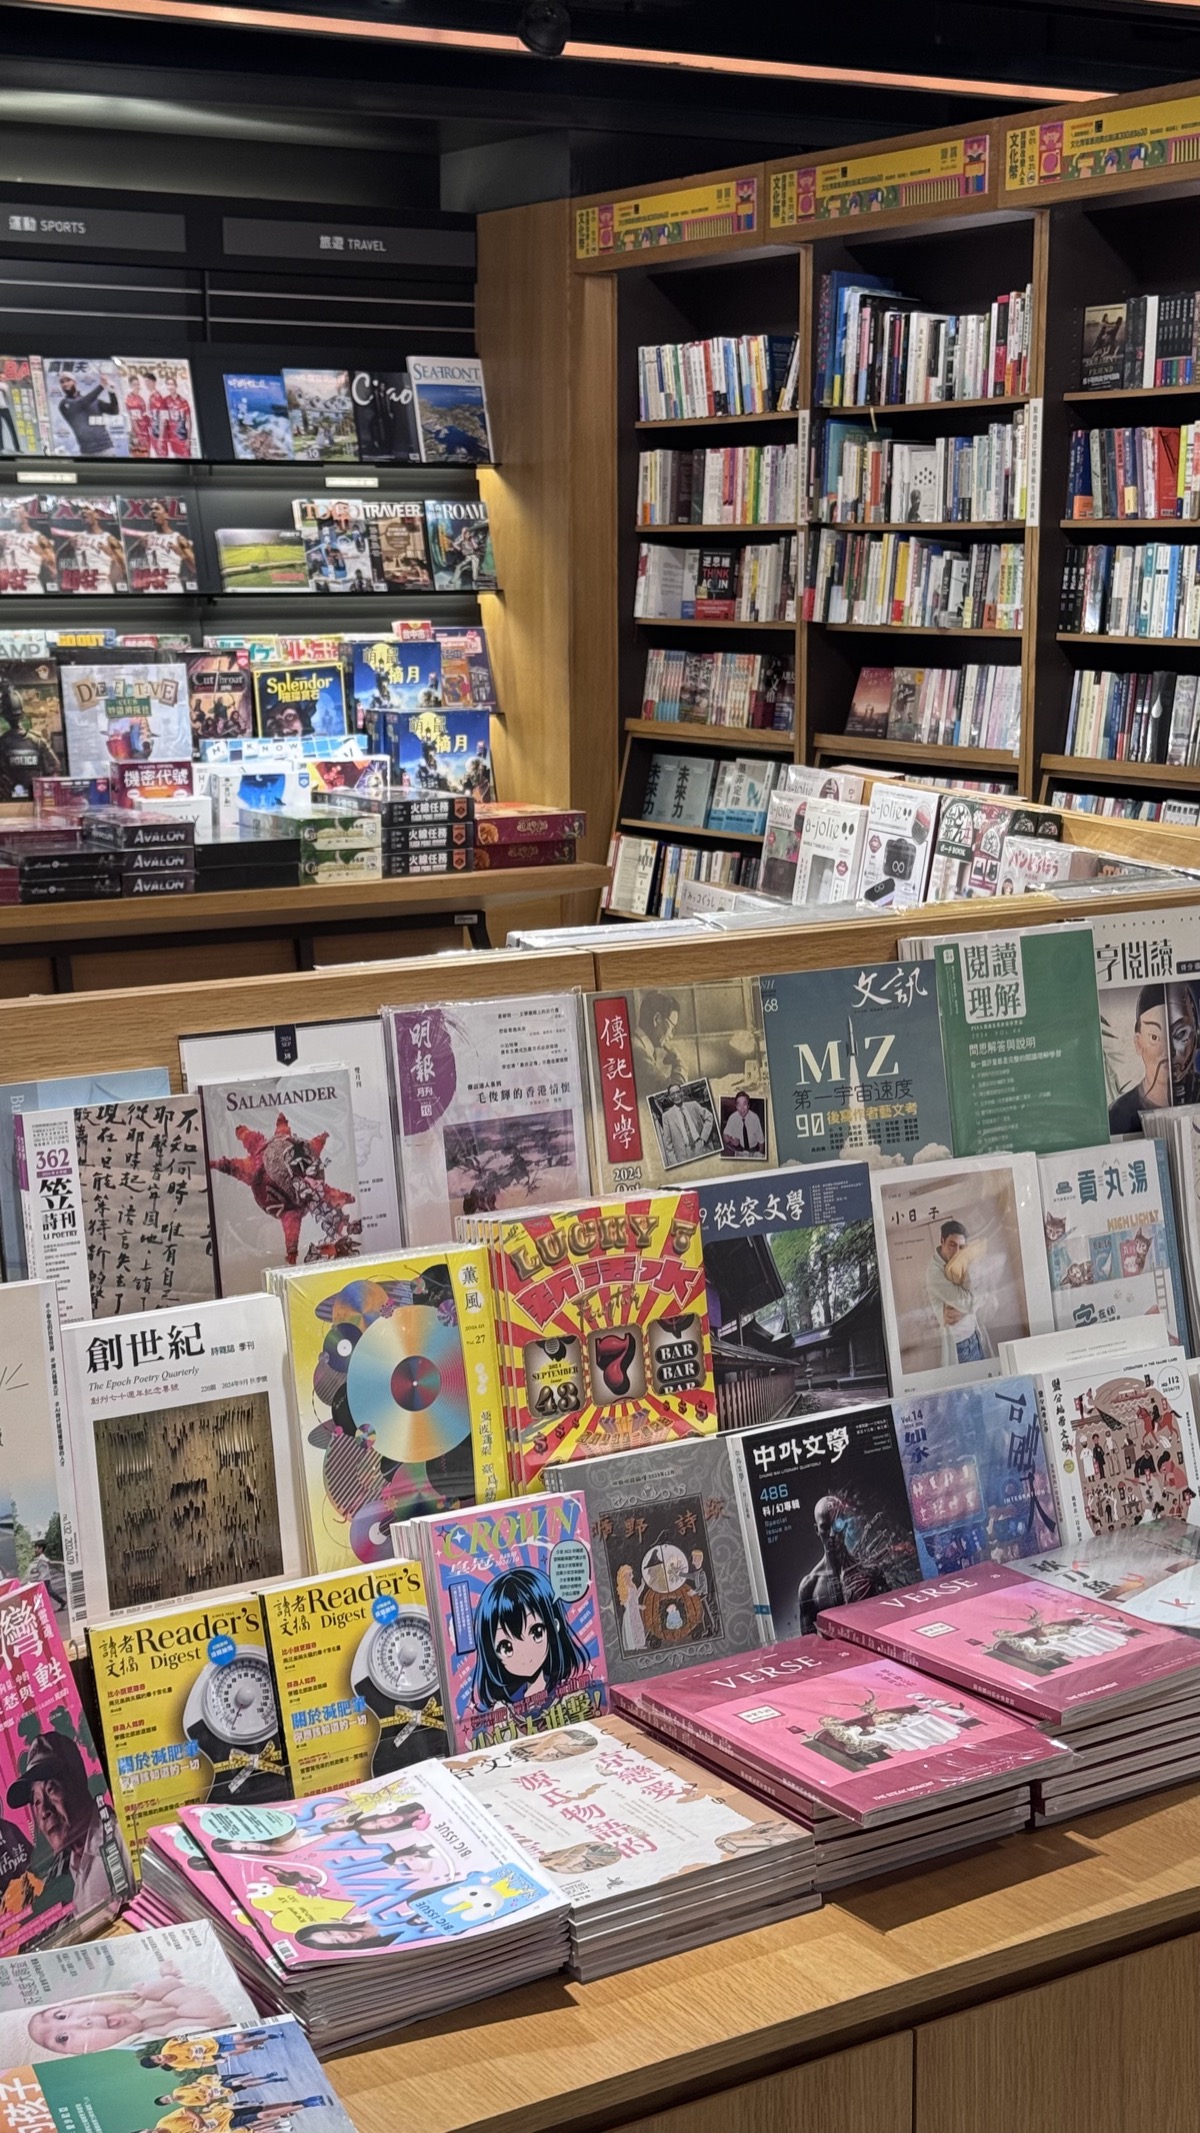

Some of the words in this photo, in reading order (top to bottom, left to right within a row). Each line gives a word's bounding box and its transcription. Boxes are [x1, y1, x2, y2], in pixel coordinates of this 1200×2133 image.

[8, 215, 37, 232] 運動
[40, 220, 87, 234] SPORTS
[348, 238, 386, 252] TRAVEL
[413, 363, 481, 381] SEAFRONT
[352, 373, 413, 406] Ciao
[443, 505, 486, 520] ROAM
[703, 557, 731, 568] 逆思維
[703, 568, 729, 579] THINK
[266, 672, 333, 694] Splendor
[388, 665, 420, 684] 摘月
[435, 734, 468, 753] 摘月
[124, 770, 188, 787] 機密代號
[642, 762, 661, 815] 未來力
[671, 765, 690, 819] 未來力
[410, 800, 449, 815] 火線任務
[871, 801, 904, 821] a-jolie
[134, 830, 186, 844] AVALON
[408, 827, 447, 842] 火線任務
[805, 819, 840, 840] a-jolie
[133, 856, 184, 868] AVALON
[409, 853, 447, 868] 火線任務
[132, 880, 184, 892] AVALON
[963, 942, 1019, 981] 閱讀
[851, 967, 928, 1008] 文訊
[968, 981, 1022, 1019] 理解
[409, 1019, 436, 1083] 明報
[416, 1086, 433, 1097] 月刊
[477, 1082, 571, 1104] 毛俊輝的香港情懷
[600, 1016, 635, 1150] 傳記文學
[792, 1078, 914, 1110] 第一宇宙速度
[226, 1086, 338, 1111] SALAMANDER
[421, 1105, 432, 1116] 10
[36, 1149, 70, 1169] 362
[613, 1167, 643, 1181] 2024
[1077, 1159, 1149, 1206] 貢丸湯
[713, 1188, 805, 1231] 從容文學
[890, 1206, 940, 1225] 小日子
[42, 1211, 76, 1232] 詩刊
[43, 1230, 50, 1240] LI
[52, 1229, 78, 1239] POETRY
[510, 1214, 660, 1281] LUCKY
[461, 1265, 482, 1310] 薰風
[513, 1255, 704, 1331] 新活水
[86, 1322, 205, 1374] 創世紀
[239, 1341, 255, 1351] 季刊
[661, 1343, 695, 1361] BAR
[532, 1366, 579, 1382] SEPTEMBER
[595, 1332, 637, 1396] 7
[662, 1363, 696, 1381] BAR
[89, 1382, 104, 1392] The
[106, 1376, 132, 1390] Epoch
[133, 1372, 160, 1386] Poetry
[161, 1366, 200, 1380] Quarterly
[664, 1381, 697, 1394] BAR
[900, 1409, 924, 1424] Vol.14
[753, 1426, 850, 1472] 中外文學
[759, 1484, 789, 1502] 486
[1003, 1489, 1045, 1504] INTEGRATION
[762, 1500, 800, 1517] 科/幻專輯
[442, 1499, 577, 1560] CROWN
[764, 1517, 788, 1527] Special
[765, 1526, 783, 1536] Issue
[1027, 1559, 1119, 1597] 秋刀魚
[307, 1568, 421, 1615] Reader's
[880, 1577, 978, 1609] VERSE
[273, 1594, 308, 1620] 讀者
[279, 1616, 311, 1638] 文摘
[320, 1607, 367, 1630] Digest
[135, 1607, 260, 1655] Reader's
[99, 1634, 136, 1660] 讀者
[105, 1656, 139, 1679] 文摘
[149, 1647, 202, 1671] Digest
[712, 1654, 823, 1691] VERSE
[291, 1695, 367, 1730] 關於減肥筆
[117, 1739, 200, 1775] 關於減肥筆
[511, 1769, 659, 1860] 源氏物語的
[434, 1820, 460, 1845] ISSUE
[415, 1901, 438, 1919] ISSUE
